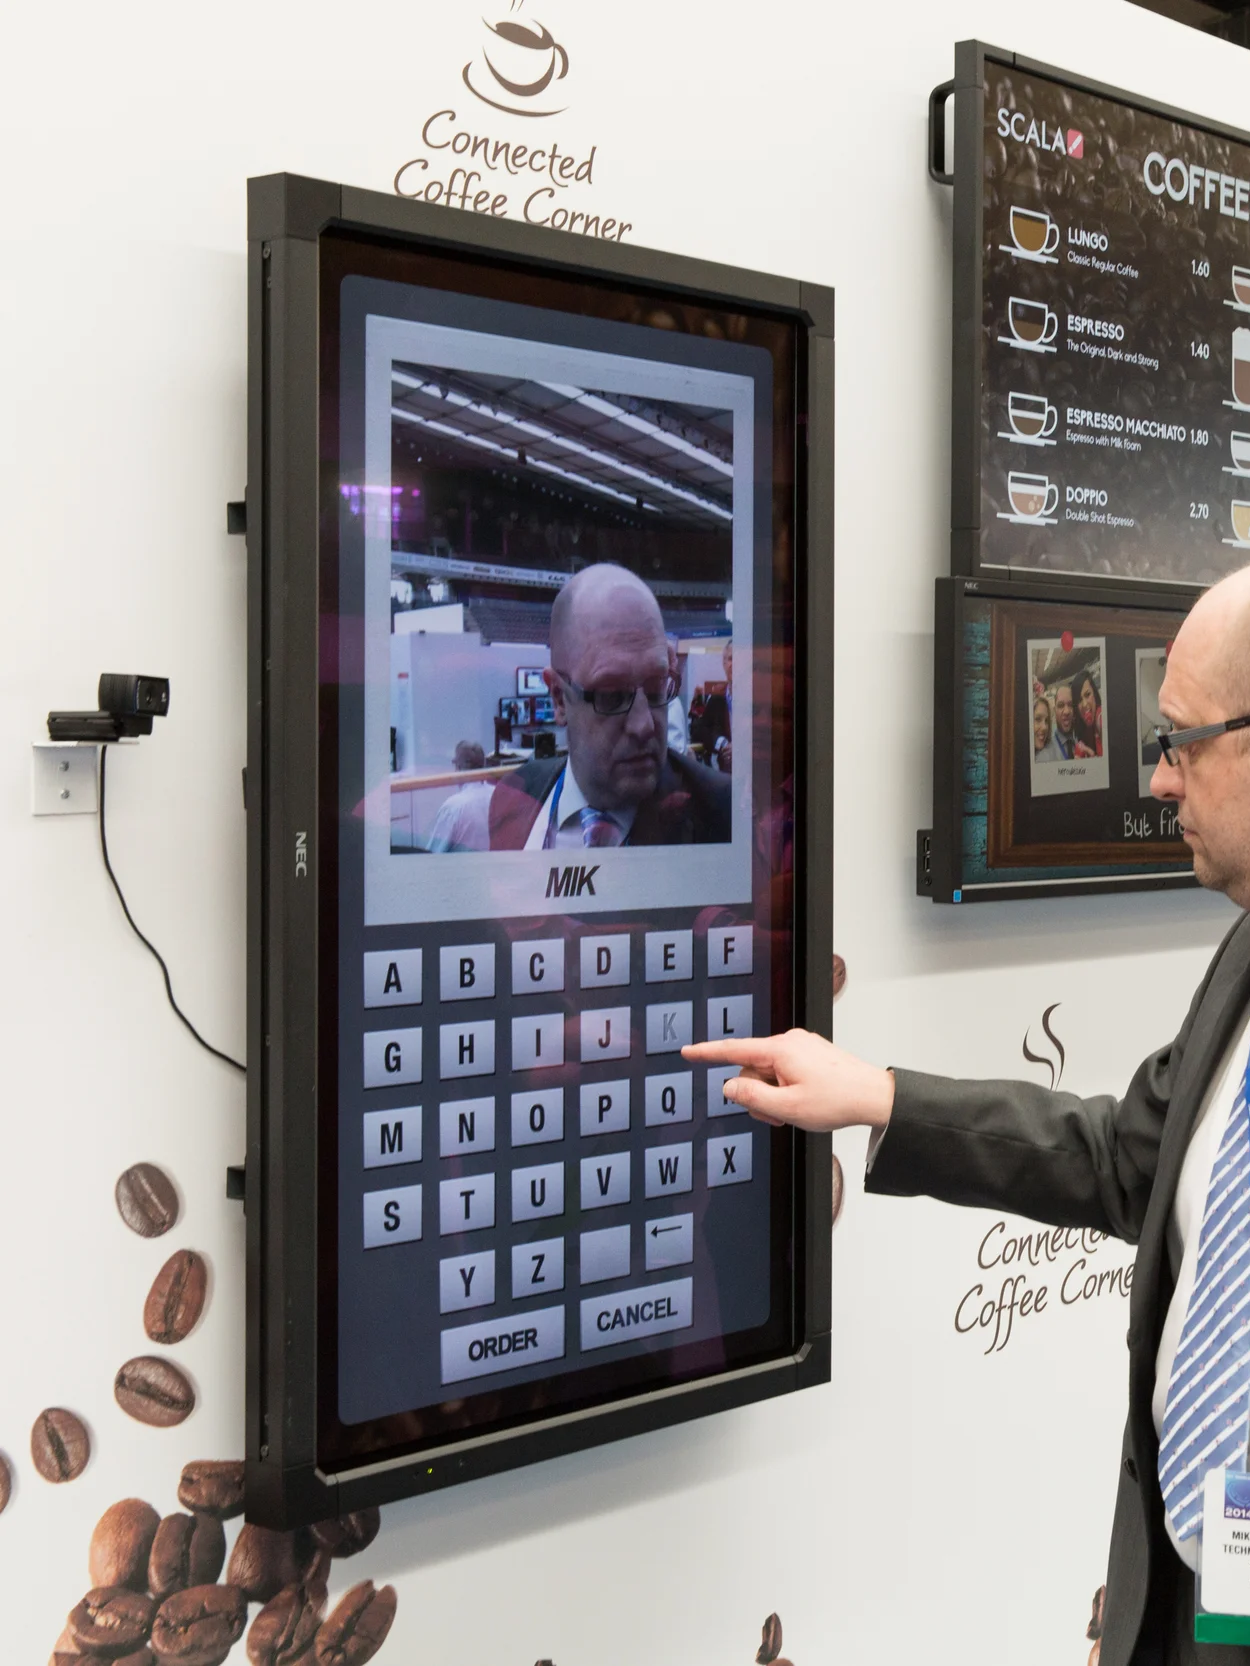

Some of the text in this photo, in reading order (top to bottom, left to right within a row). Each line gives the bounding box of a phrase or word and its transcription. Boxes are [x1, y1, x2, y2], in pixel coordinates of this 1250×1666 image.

[421, 110, 597, 187] Connected
[997, 107, 1066, 156] SCALA
[393, 158, 632, 242] Coffee Corner
[1068, 226, 1108, 252] LUNGO
[1067, 250, 1139, 279] Classic Regular Coffee
[1191, 259, 1210, 278] 1.60
[1067, 314, 1125, 341] ESPRESSO
[1067, 339, 1080, 352] The
[1107, 347, 1123, 361] Dark
[1123, 352, 1138, 364] and
[1138, 353, 1159, 371] Strong
[1190, 341, 1210, 360] 1.40
[1066, 407, 1187, 442] ESPRESSO MACCHIATO
[1066, 429, 1095, 444] Espresso
[1095, 434, 1110, 446] with
[1110, 435, 1123, 449] Milk
[1190, 428, 1209, 446] 1.80
[1066, 485, 1108, 507] DOPPIO
[1065, 508, 1135, 528] Double Shot Espresso
[1124, 811, 1152, 838] But
[295, 831, 307, 878] NEC
[545, 865, 600, 898] MIK
[383, 936, 735, 994] A B C D E F
[384, 1041, 401, 1073] G
[458, 1033, 475, 1065] H
[598, 1019, 611, 1048] J
[662, 1012, 678, 1042] K
[723, 1007, 735, 1035] L
[380, 1086, 677, 1155] M N O P Q
[383, 1146, 737, 1232] S T U V W X
[977, 1221, 1109, 1270] Connecte
[459, 1254, 546, 1297] Y Z
[596, 1297, 678, 1332] CANCEL
[954, 1258, 1135, 1355] Coffee Corne
[468, 1327, 539, 1361] ORDER
